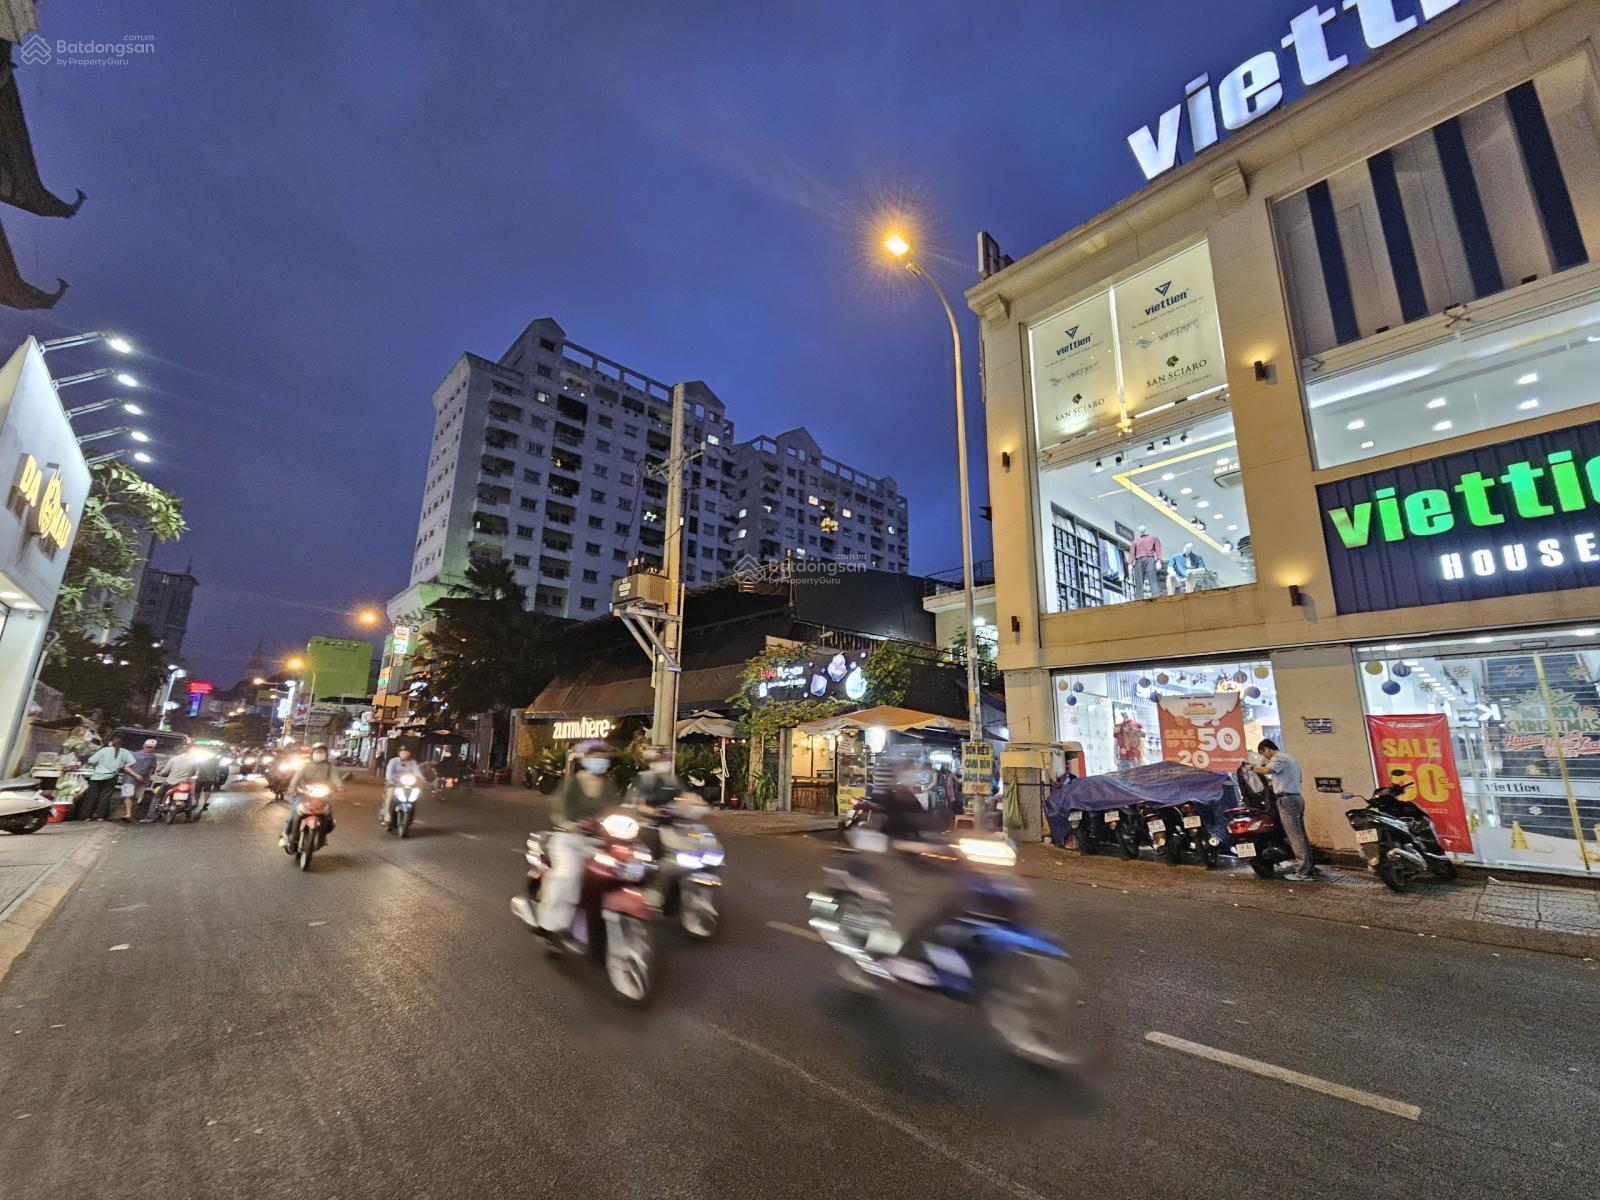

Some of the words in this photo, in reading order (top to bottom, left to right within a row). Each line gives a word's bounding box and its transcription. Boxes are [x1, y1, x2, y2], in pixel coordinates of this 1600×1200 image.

[1145, 291, 1187, 316] viettien
[1056, 335, 1091, 357] viettien
[1146, 374, 1166, 388] SAN
[1167, 359, 1207, 380] SCIARO
[1055, 409, 1071, 422] SAN
[1440, 532, 1600, 581] HOUSE
[1382, 737, 1442, 758] SALE
